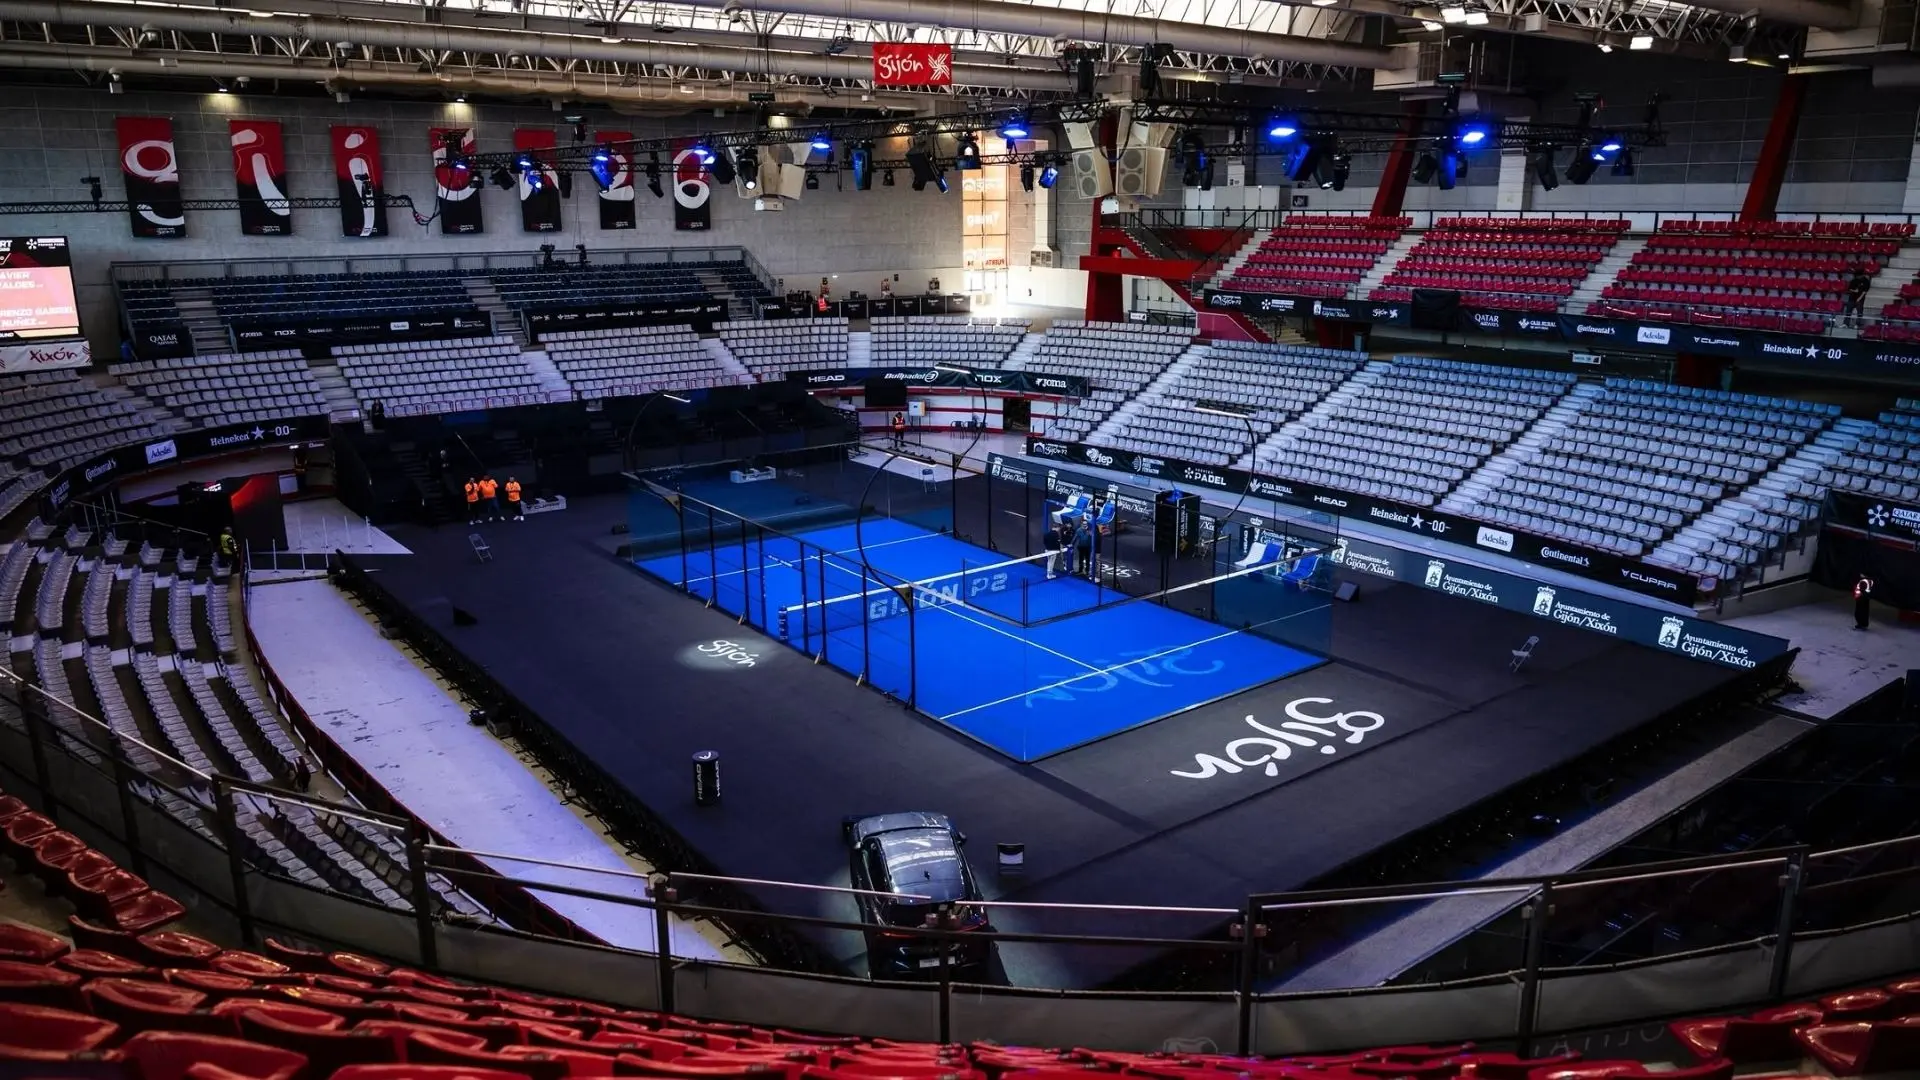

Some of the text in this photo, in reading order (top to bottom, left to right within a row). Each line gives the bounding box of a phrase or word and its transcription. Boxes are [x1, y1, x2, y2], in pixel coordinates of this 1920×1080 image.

[879, 53, 924, 80] gijón
[1475, 313, 1499, 323] QATAR
[1577, 324, 1610, 334] Continental
[1642, 331, 1666, 340] Adeslas
[150, 334, 177, 343] QATAR
[1701, 338, 1740, 347] CUPRA
[1763, 343, 1803, 355] Heineken
[1875, 354, 1920, 365] METROPO
[808, 374, 845, 383] HEAD
[210, 431, 250, 447] Heineken
[1194, 472, 1227, 486] PADEL
[1314, 494, 1348, 508] HEAD
[1371, 506, 1409, 524] Heineken
[1893, 509, 1918, 520] QATAR
[1482, 533, 1508, 546] Adeslas
[1347, 550, 1382, 563] Ayuntamiento
[1540, 546, 1583, 566] Continental
[1444, 574, 1484, 589] Ayuntamiento
[1630, 572, 1678, 591] CUPRA
[869, 572, 1008, 620] GIÓN P2
[1442, 580, 1499, 604] Gijón/Xixón
[1555, 601, 1611, 621] Ayuntamiento de
[1553, 608, 1617, 634] Gijón/Xixón
[1683, 633, 1749, 655] Ayuntamiento de
[1681, 641, 1757, 669] Gijón/Xixón
